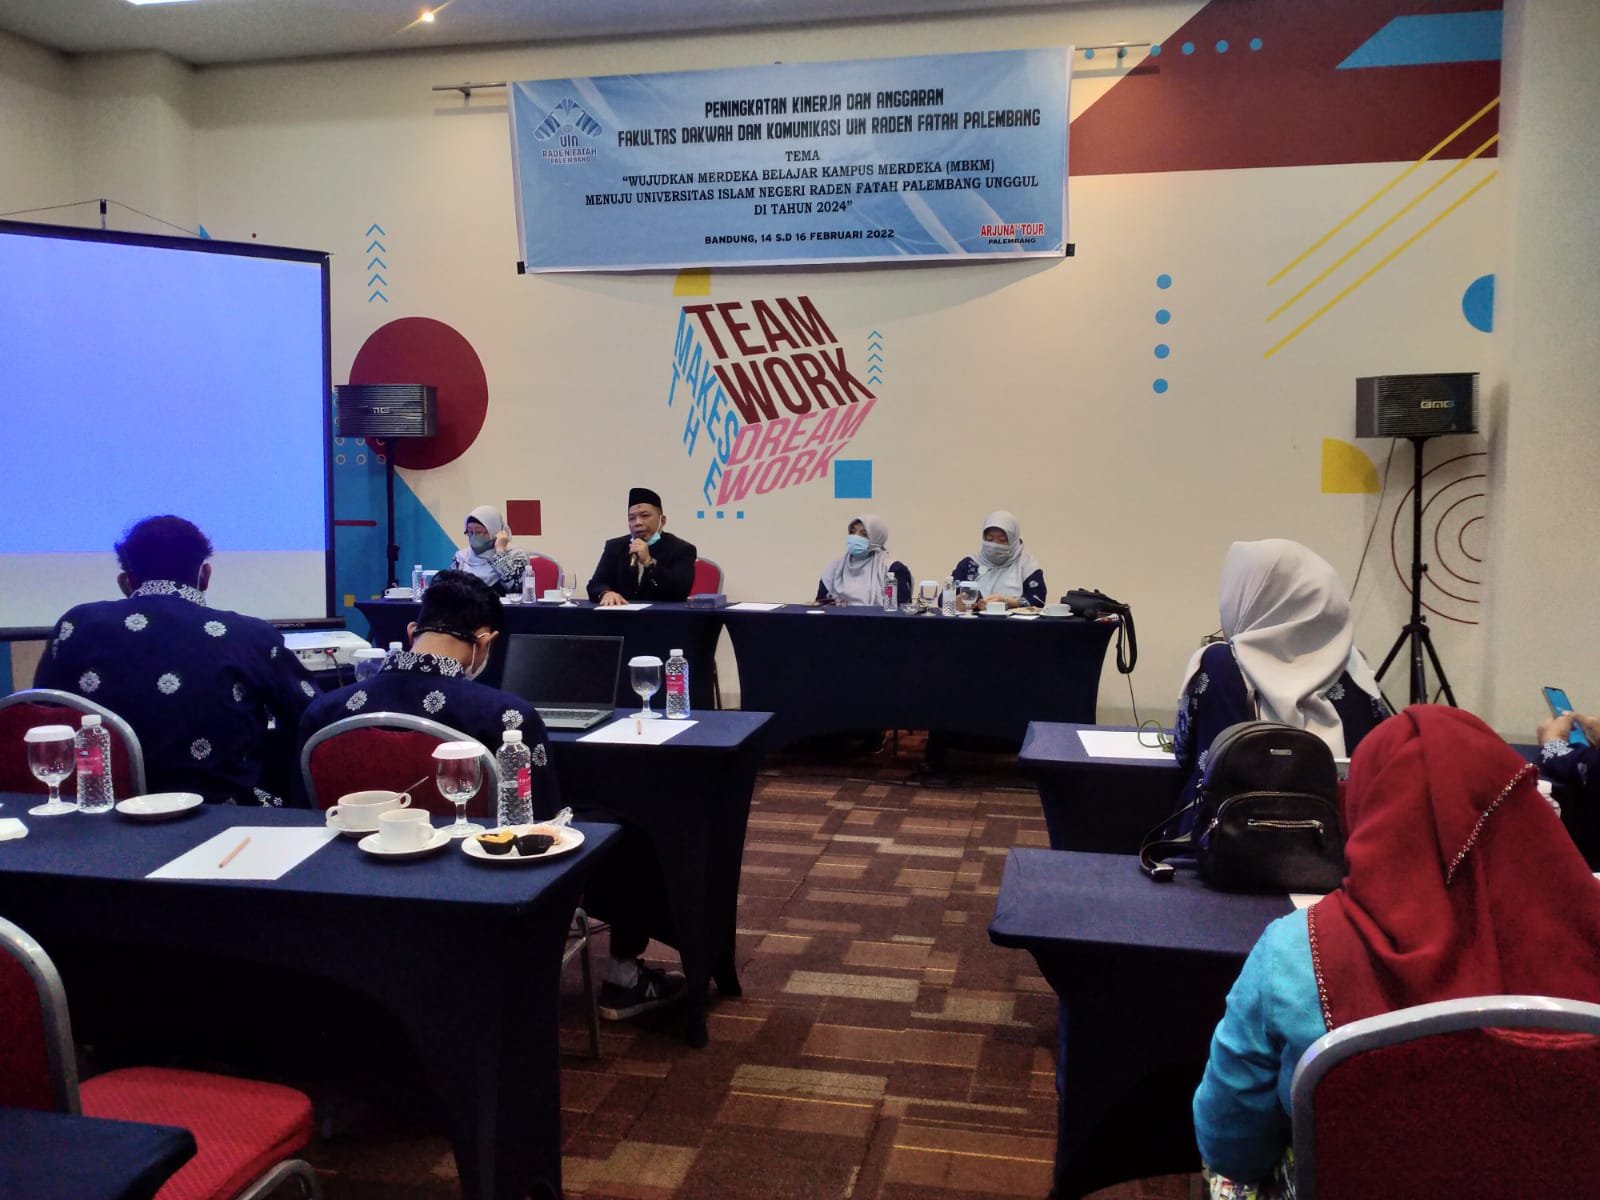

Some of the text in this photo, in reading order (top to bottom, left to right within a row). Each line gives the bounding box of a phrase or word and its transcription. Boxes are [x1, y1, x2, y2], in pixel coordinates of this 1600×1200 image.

[705, 88, 944, 119] PENINGKATAN KINERJA DAN ANGGARAN
[618, 108, 1041, 147] FAKULTAS DAKWAH DAN KOMUNIKASI UIN RADEN FATAH PALEMBANG
[572, 147, 597, 155] FATAH
[785, 150, 820, 162] TEMA
[698, 172, 758, 184] MERDEKA
[762, 166, 818, 182] BELAJAR
[821, 164, 874, 178] KAMPUS
[878, 162, 942, 175] MERDEKA
[946, 159, 995, 175] (MBKM)
[585, 175, 1039, 206] MENUJU UNIVERSITAS ISLAM NEGERI RADEN FATAH PALEMBANG UNGGUL
[754, 204, 767, 216] DI
[771, 201, 812, 215] TAHUN
[705, 229, 895, 245] BANDUNG, 14 S.D 16 FEBRUARI 2022
[980, 223, 1044, 237] ARJUNA TOUR
[988, 237, 1037, 245] PALEMBANG
[682, 295, 839, 360] TEAM
[674, 306, 740, 465] MAKES
[713, 347, 877, 425] WORK
[727, 398, 878, 467] DREAM
[715, 441, 849, 507] WORK
